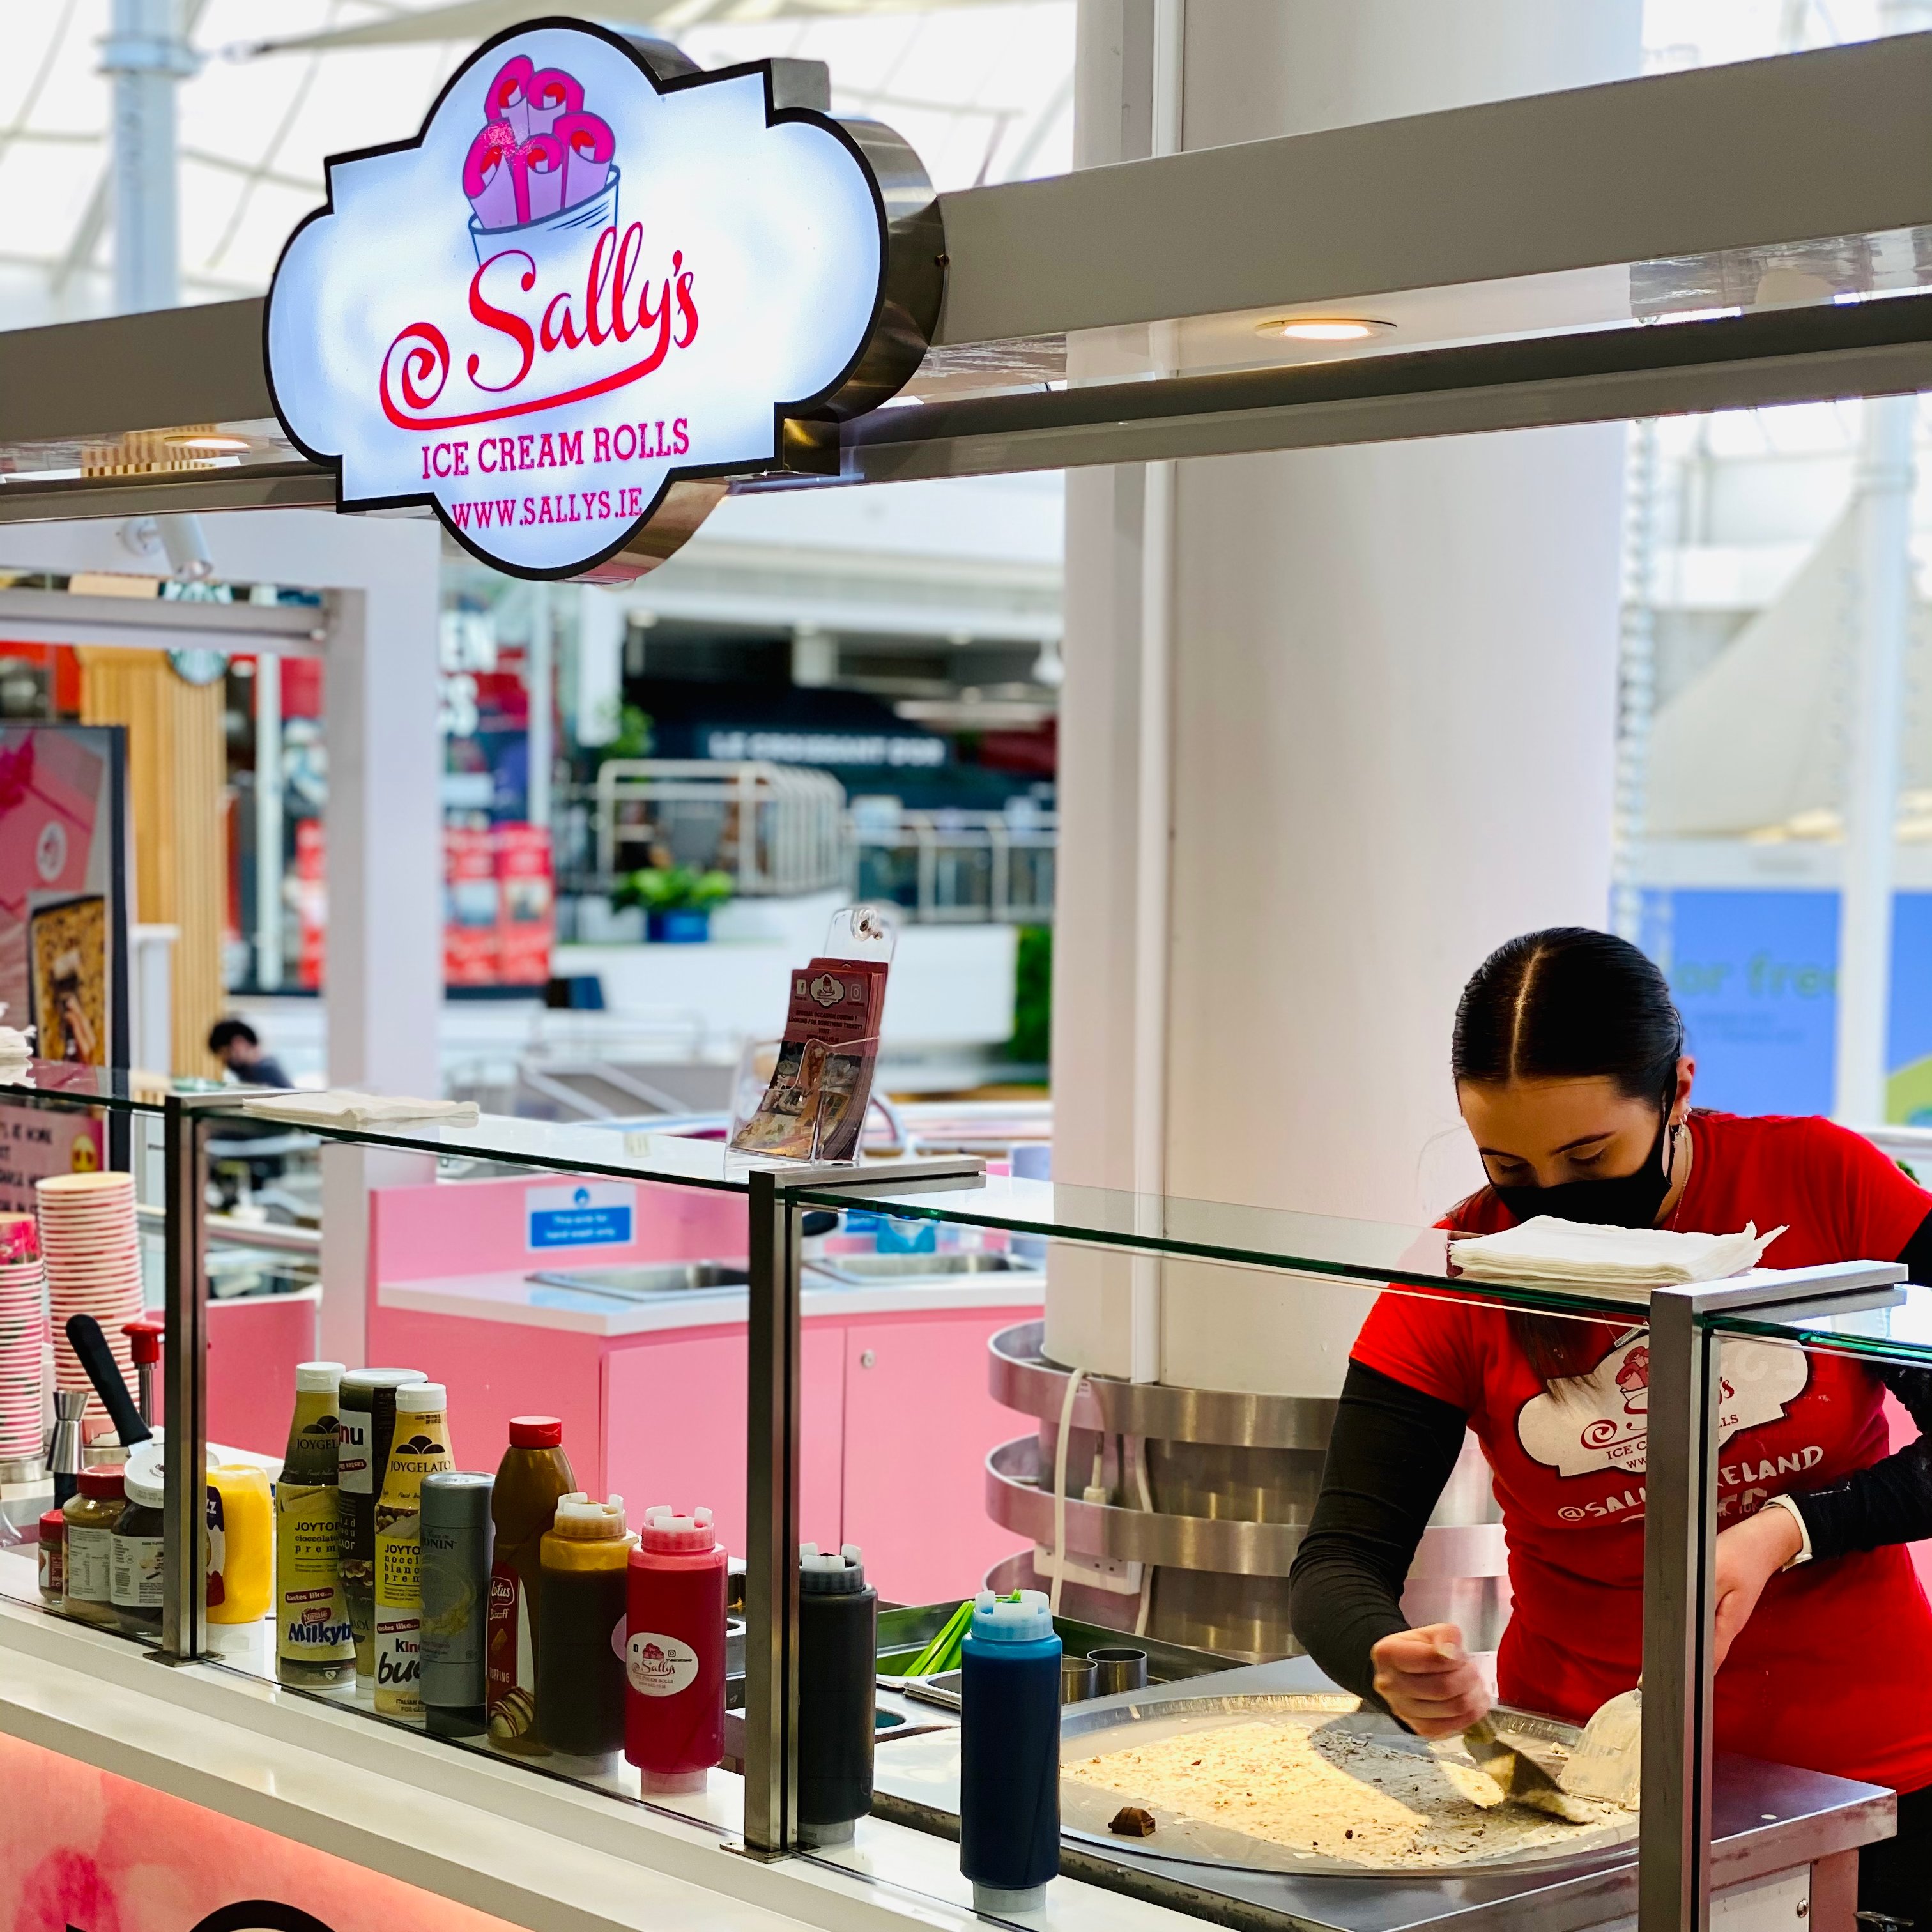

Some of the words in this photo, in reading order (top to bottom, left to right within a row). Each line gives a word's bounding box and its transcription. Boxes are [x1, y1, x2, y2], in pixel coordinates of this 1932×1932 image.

[379, 222, 698, 430] Sally's
[422, 442, 470, 479] ICE
[478, 431, 584, 473] CREAM
[593, 417, 689, 463] ROLLS
[452, 487, 643, 530] WWW.SALLYS.IE
[296, 1438, 339, 1452] JOYGEL
[1606, 1445, 1634, 1460] ICE
[390, 1460, 451, 1473] JOYGELATO
[1717, 1446, 1824, 1487] ELAND
[295, 1545, 337, 1554] prem
[385, 1544, 420, 1555] JOYTO
[385, 1554, 419, 1565] nocci
[385, 1563, 420, 1574] bianc
[288, 1621, 351, 1646] Milkyb
